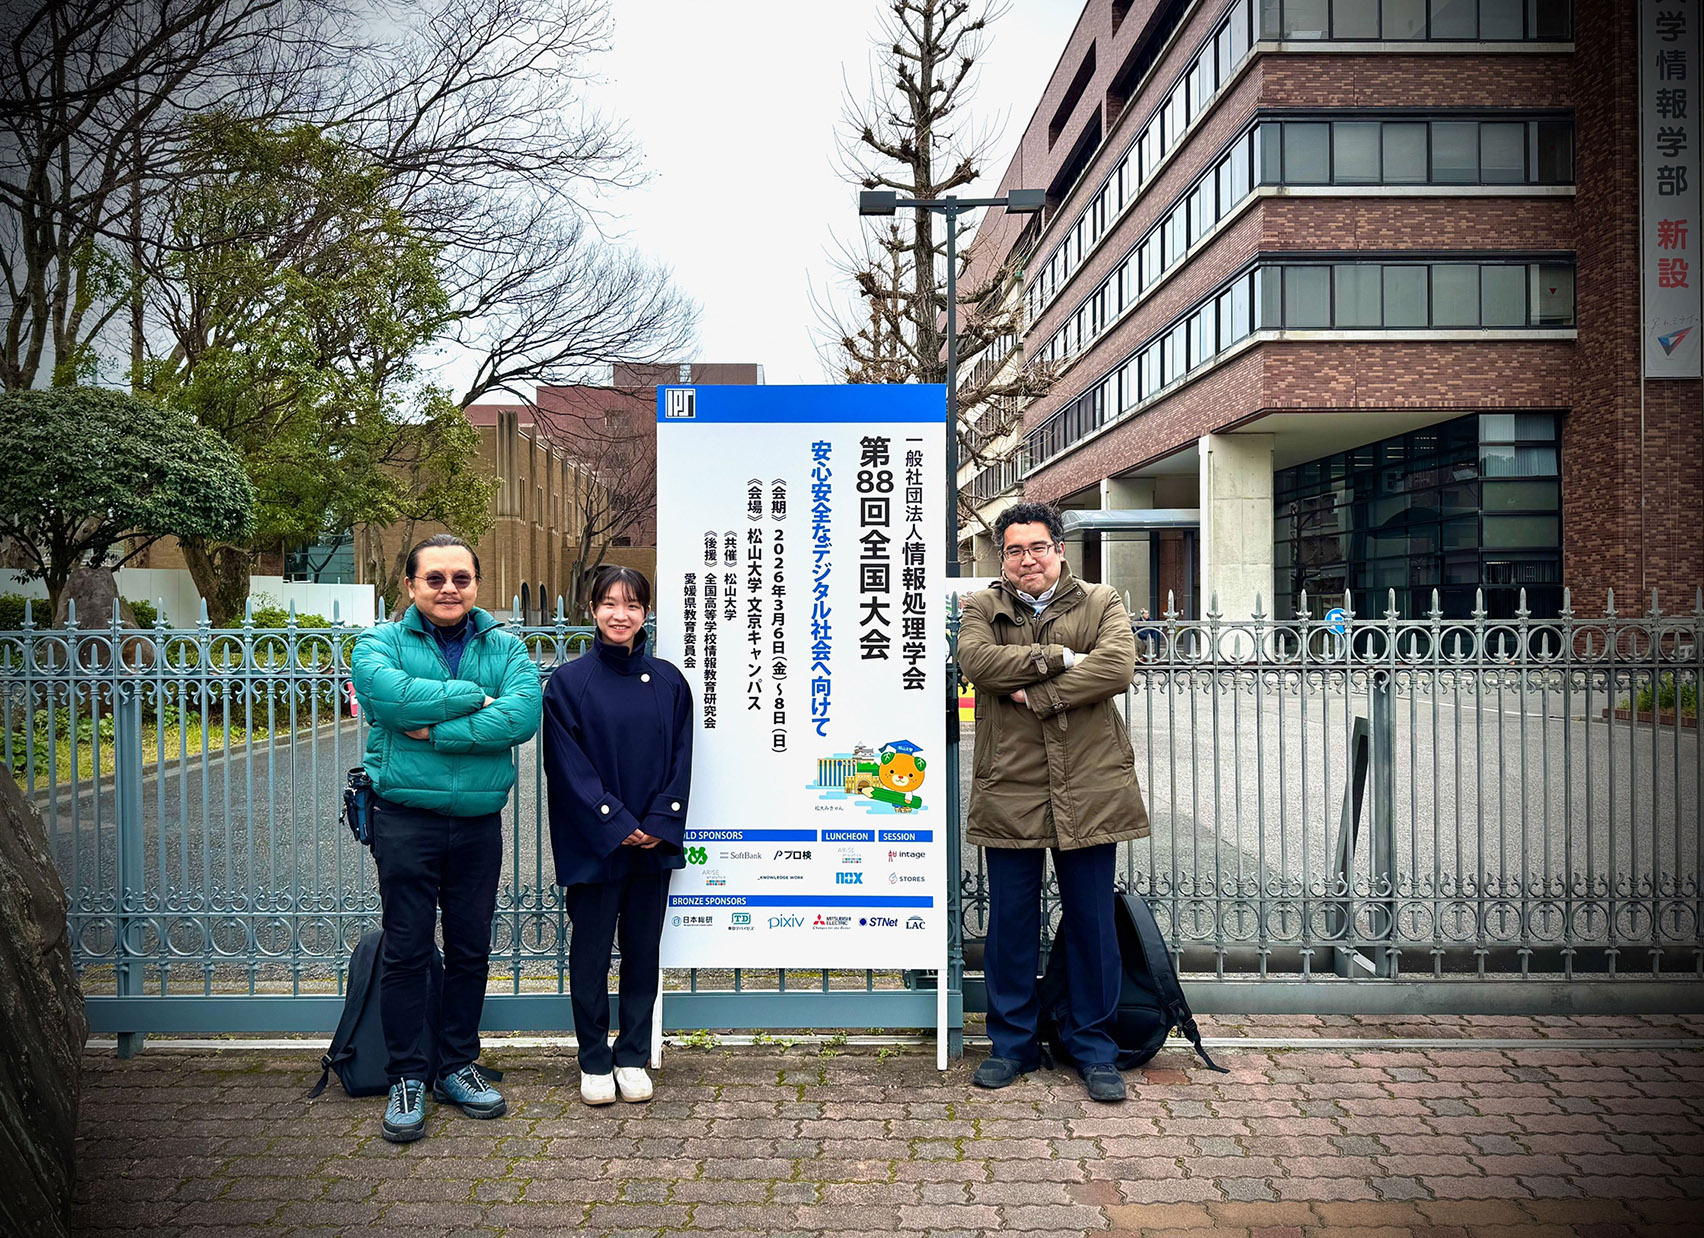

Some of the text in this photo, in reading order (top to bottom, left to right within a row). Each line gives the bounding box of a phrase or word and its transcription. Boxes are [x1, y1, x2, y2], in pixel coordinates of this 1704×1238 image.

[1656, 0, 1689, 289] 学情報学部 新設
[748, 528, 762, 593] 松山大学
[856, 436, 894, 660] 第88回全国大会
[902, 439, 926, 690] 一般社団法人情報処理学会
[684, 573, 696, 668] 愛媛県教育委員会
[724, 573, 737, 621] 松山大学
[811, 440, 832, 737] 安心安全なデジタル社会へ向けて
[704, 573, 717, 728] 全国高等学校情報教育研究会
[684, 831, 743, 840] LD SPONSORS
[899, 851, 925, 859] intage
[705, 897, 746, 905] SPONSORS
[768, 914, 804, 929] pixiv
[869, 917, 898, 927] STNet
